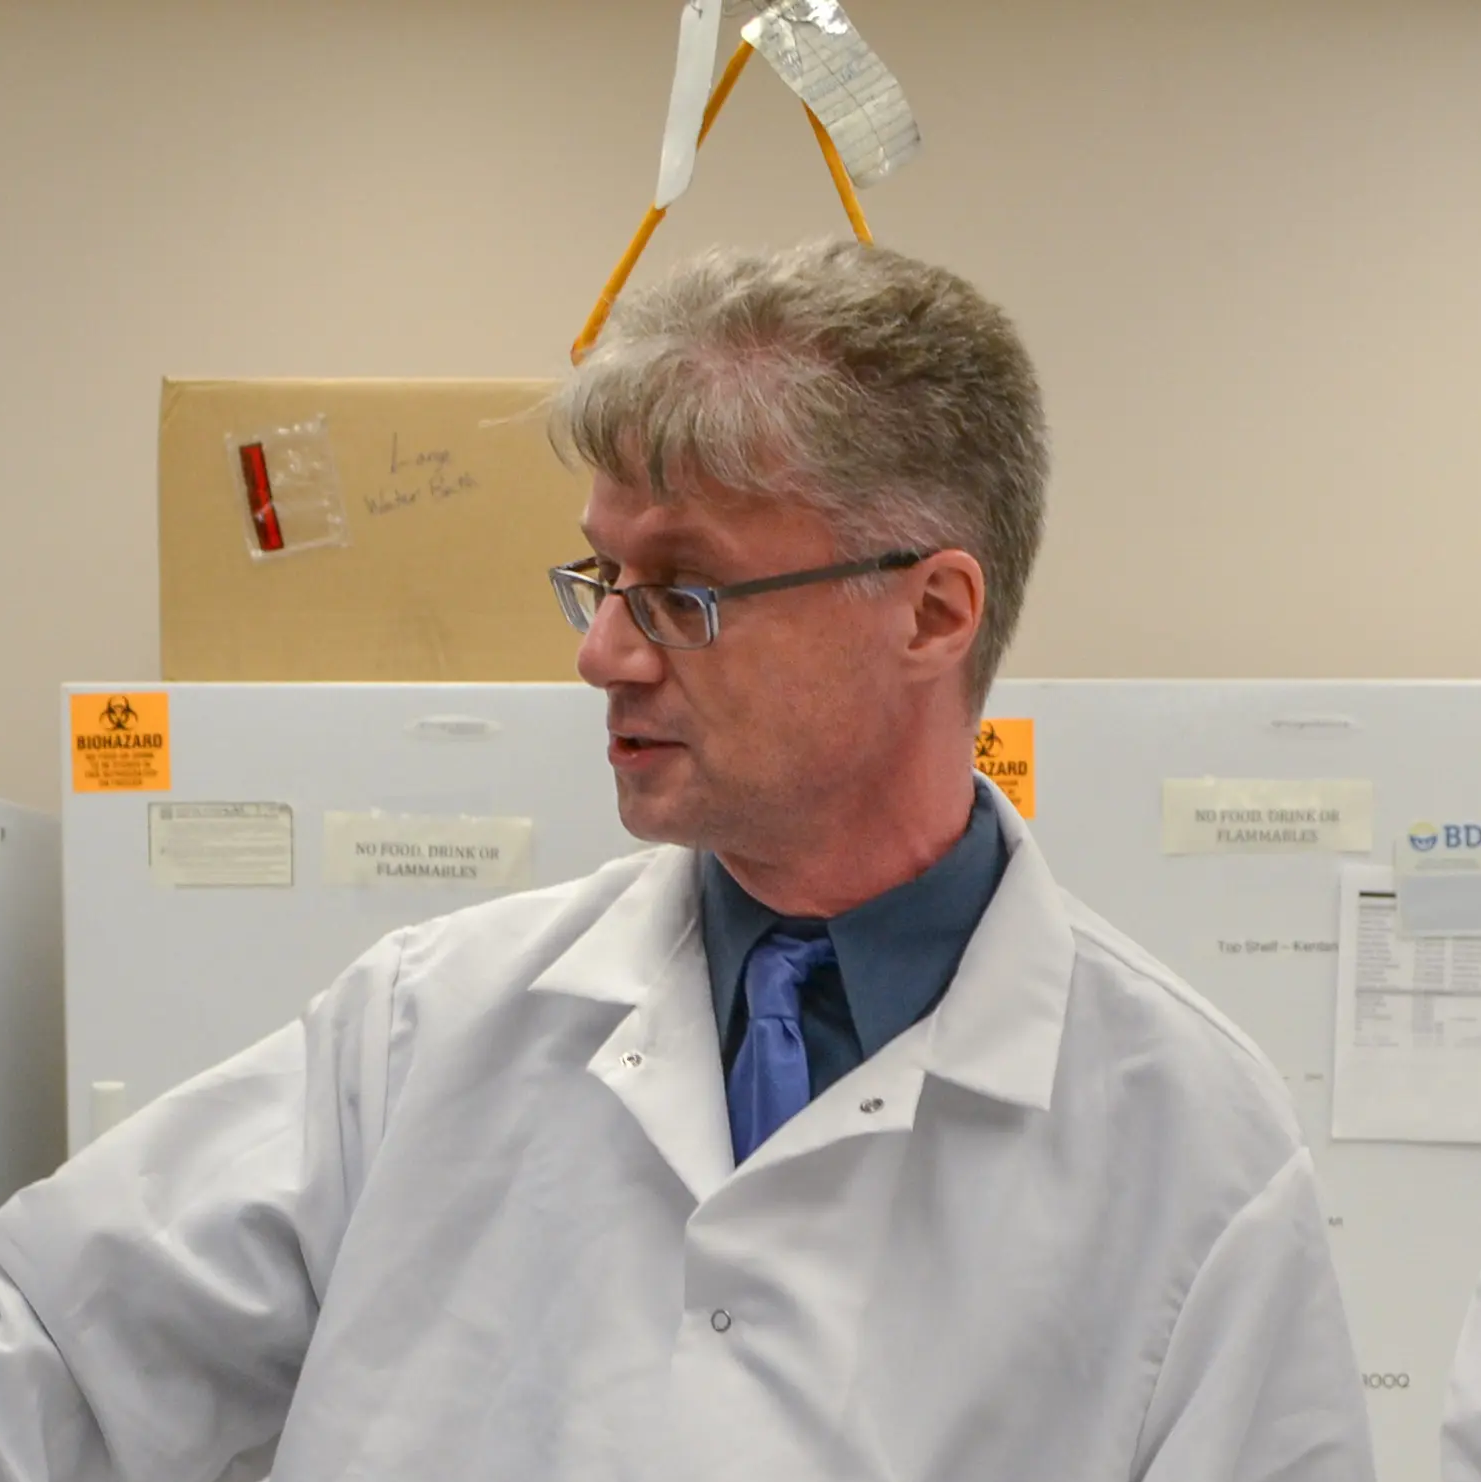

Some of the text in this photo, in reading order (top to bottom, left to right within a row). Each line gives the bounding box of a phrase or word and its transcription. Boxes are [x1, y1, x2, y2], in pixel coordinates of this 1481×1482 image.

[77, 733, 163, 750] BIOHAZARD
[1195, 808, 1217, 823] NO
[1267, 808, 1316, 824] DRINK
[1320, 809, 1340, 823] OR
[1216, 828, 1319, 844] FLAMMABLES
[355, 842, 376, 857] NO
[428, 844, 476, 860] DRINK
[479, 845, 500, 861] OR
[376, 861, 478, 879] FLAMMABLES
